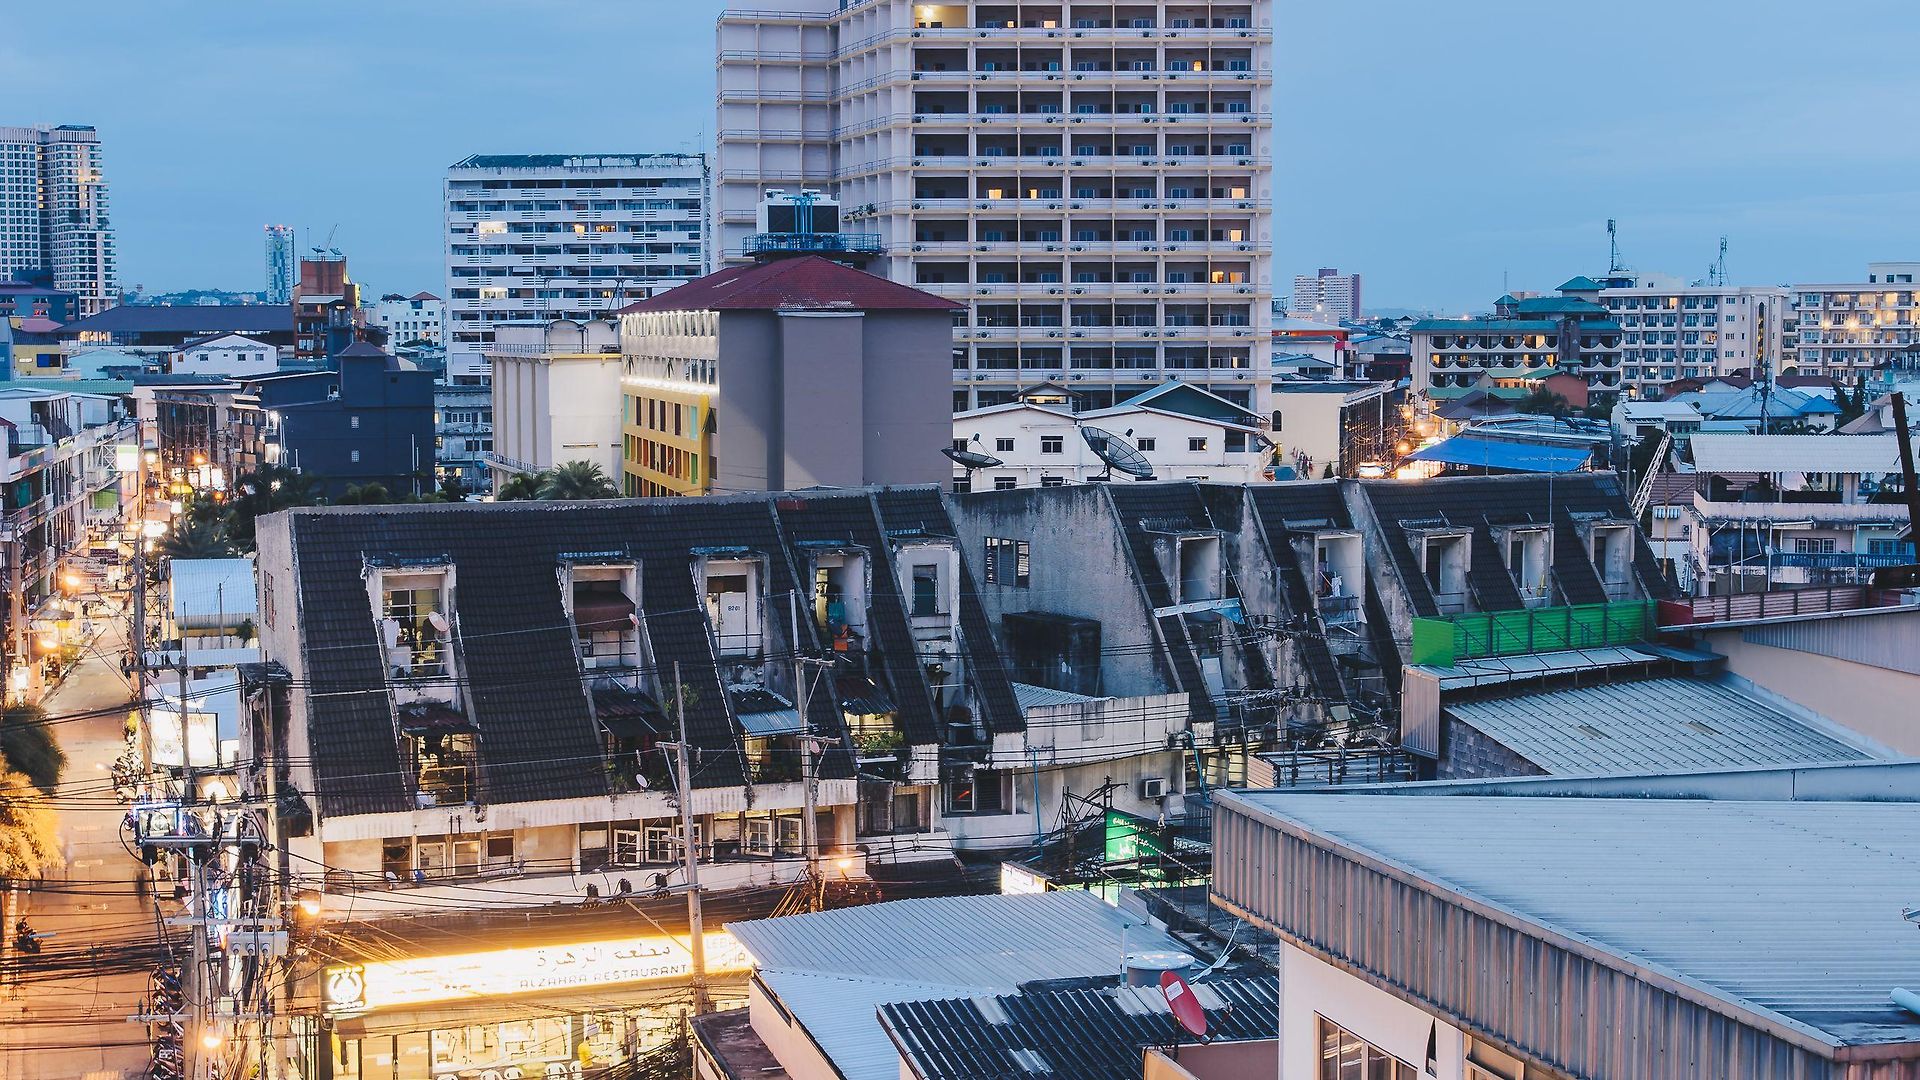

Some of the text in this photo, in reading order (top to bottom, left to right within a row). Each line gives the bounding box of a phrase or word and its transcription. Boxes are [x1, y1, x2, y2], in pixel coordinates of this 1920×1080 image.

[706, 935, 741, 949] LEBA
[520, 964, 687, 988] ALZAHRA RESTAURANT
